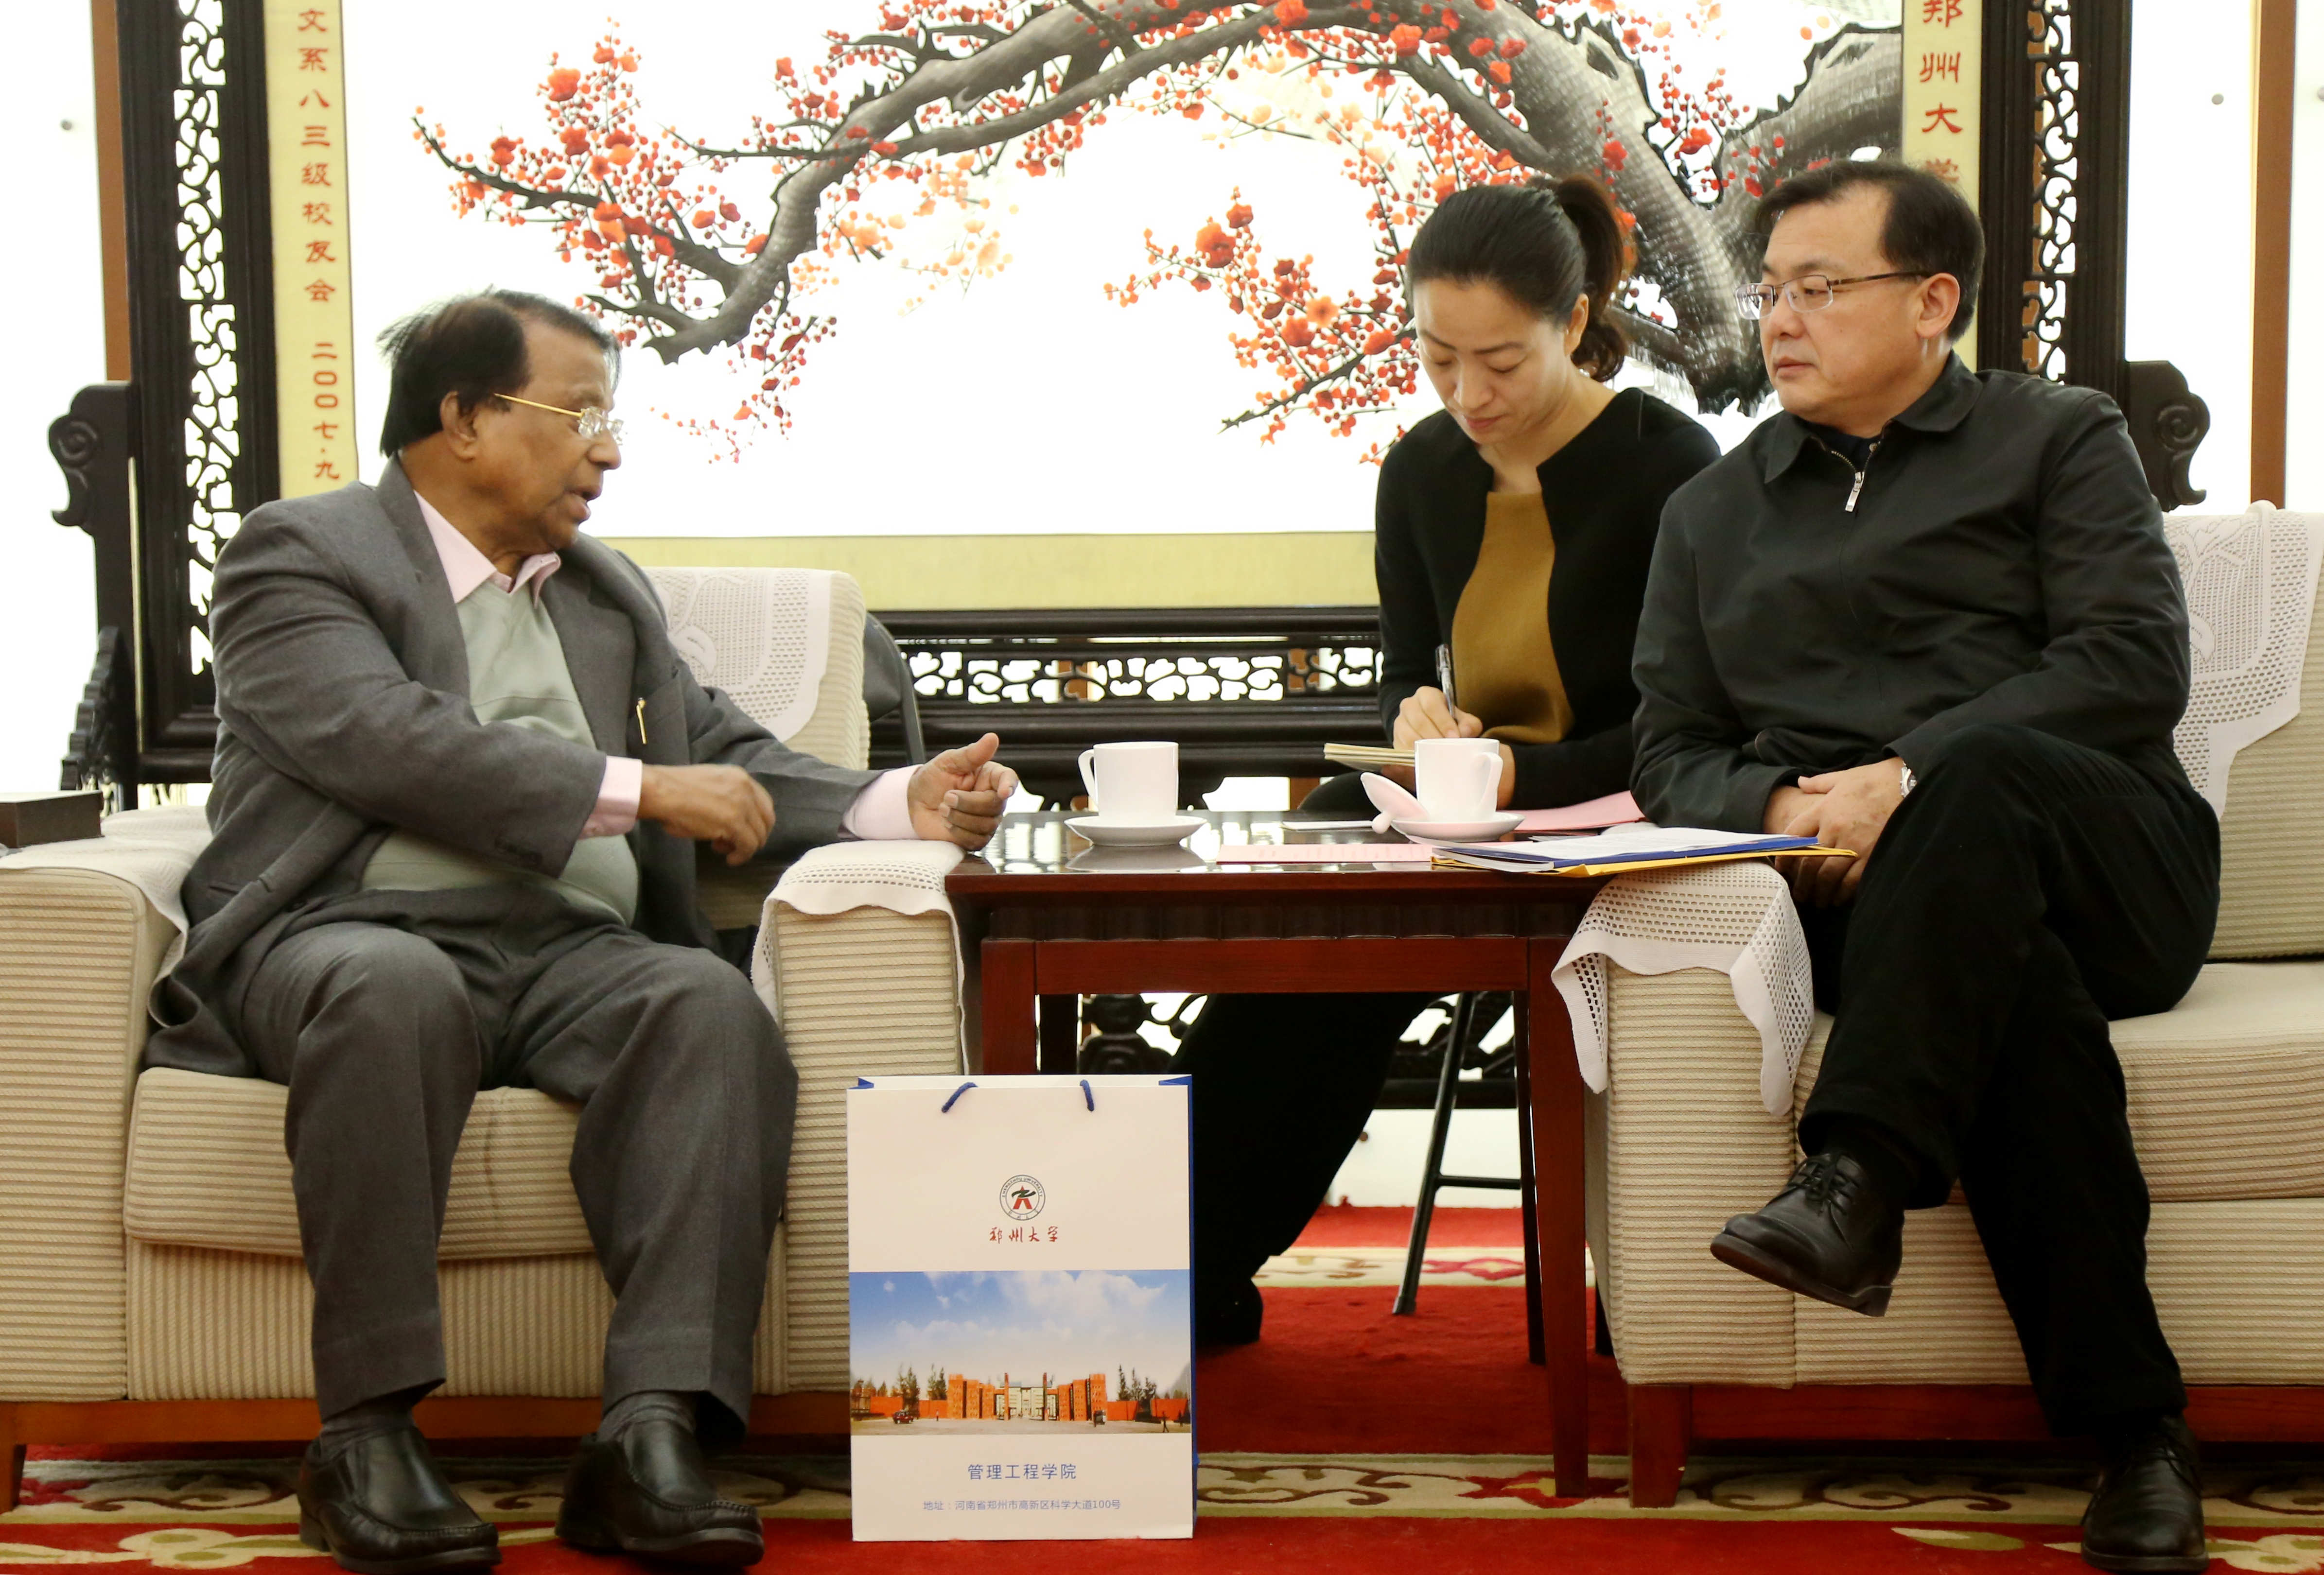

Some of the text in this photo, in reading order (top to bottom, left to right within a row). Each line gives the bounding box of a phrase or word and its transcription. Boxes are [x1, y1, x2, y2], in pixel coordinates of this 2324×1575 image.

[297, 7, 336, 302] 文系八三级校友会
[989, 1226, 1058, 1244] 郑州大学
[967, 1463, 1077, 1480] 管理工程学院
